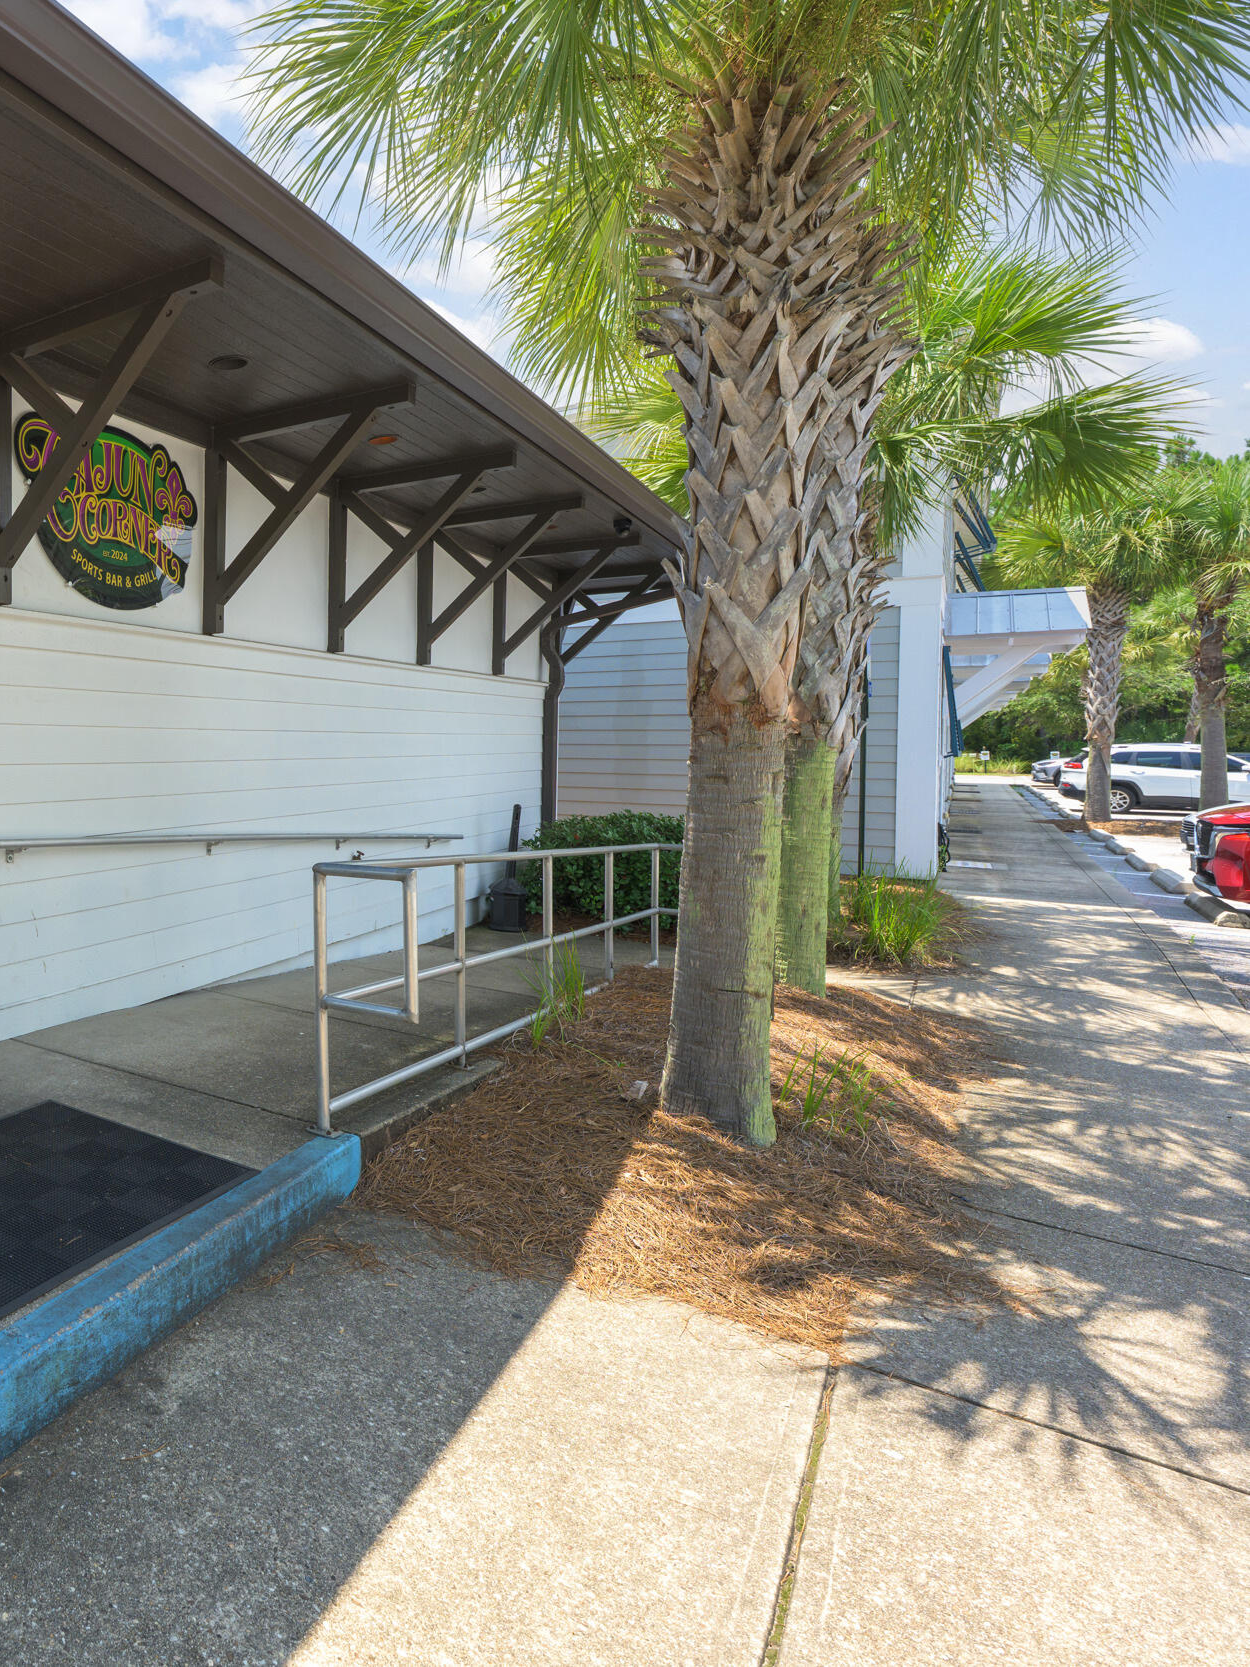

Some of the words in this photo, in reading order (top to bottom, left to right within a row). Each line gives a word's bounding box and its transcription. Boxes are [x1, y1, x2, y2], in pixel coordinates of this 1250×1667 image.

[78, 491, 181, 585] CORNER
[111, 549, 128, 561] 2024
[70, 548, 104, 581] SPORTS
[105, 571, 123, 588] BAR
[125, 575, 132, 588] &
[134, 569, 157, 587] GRILL
